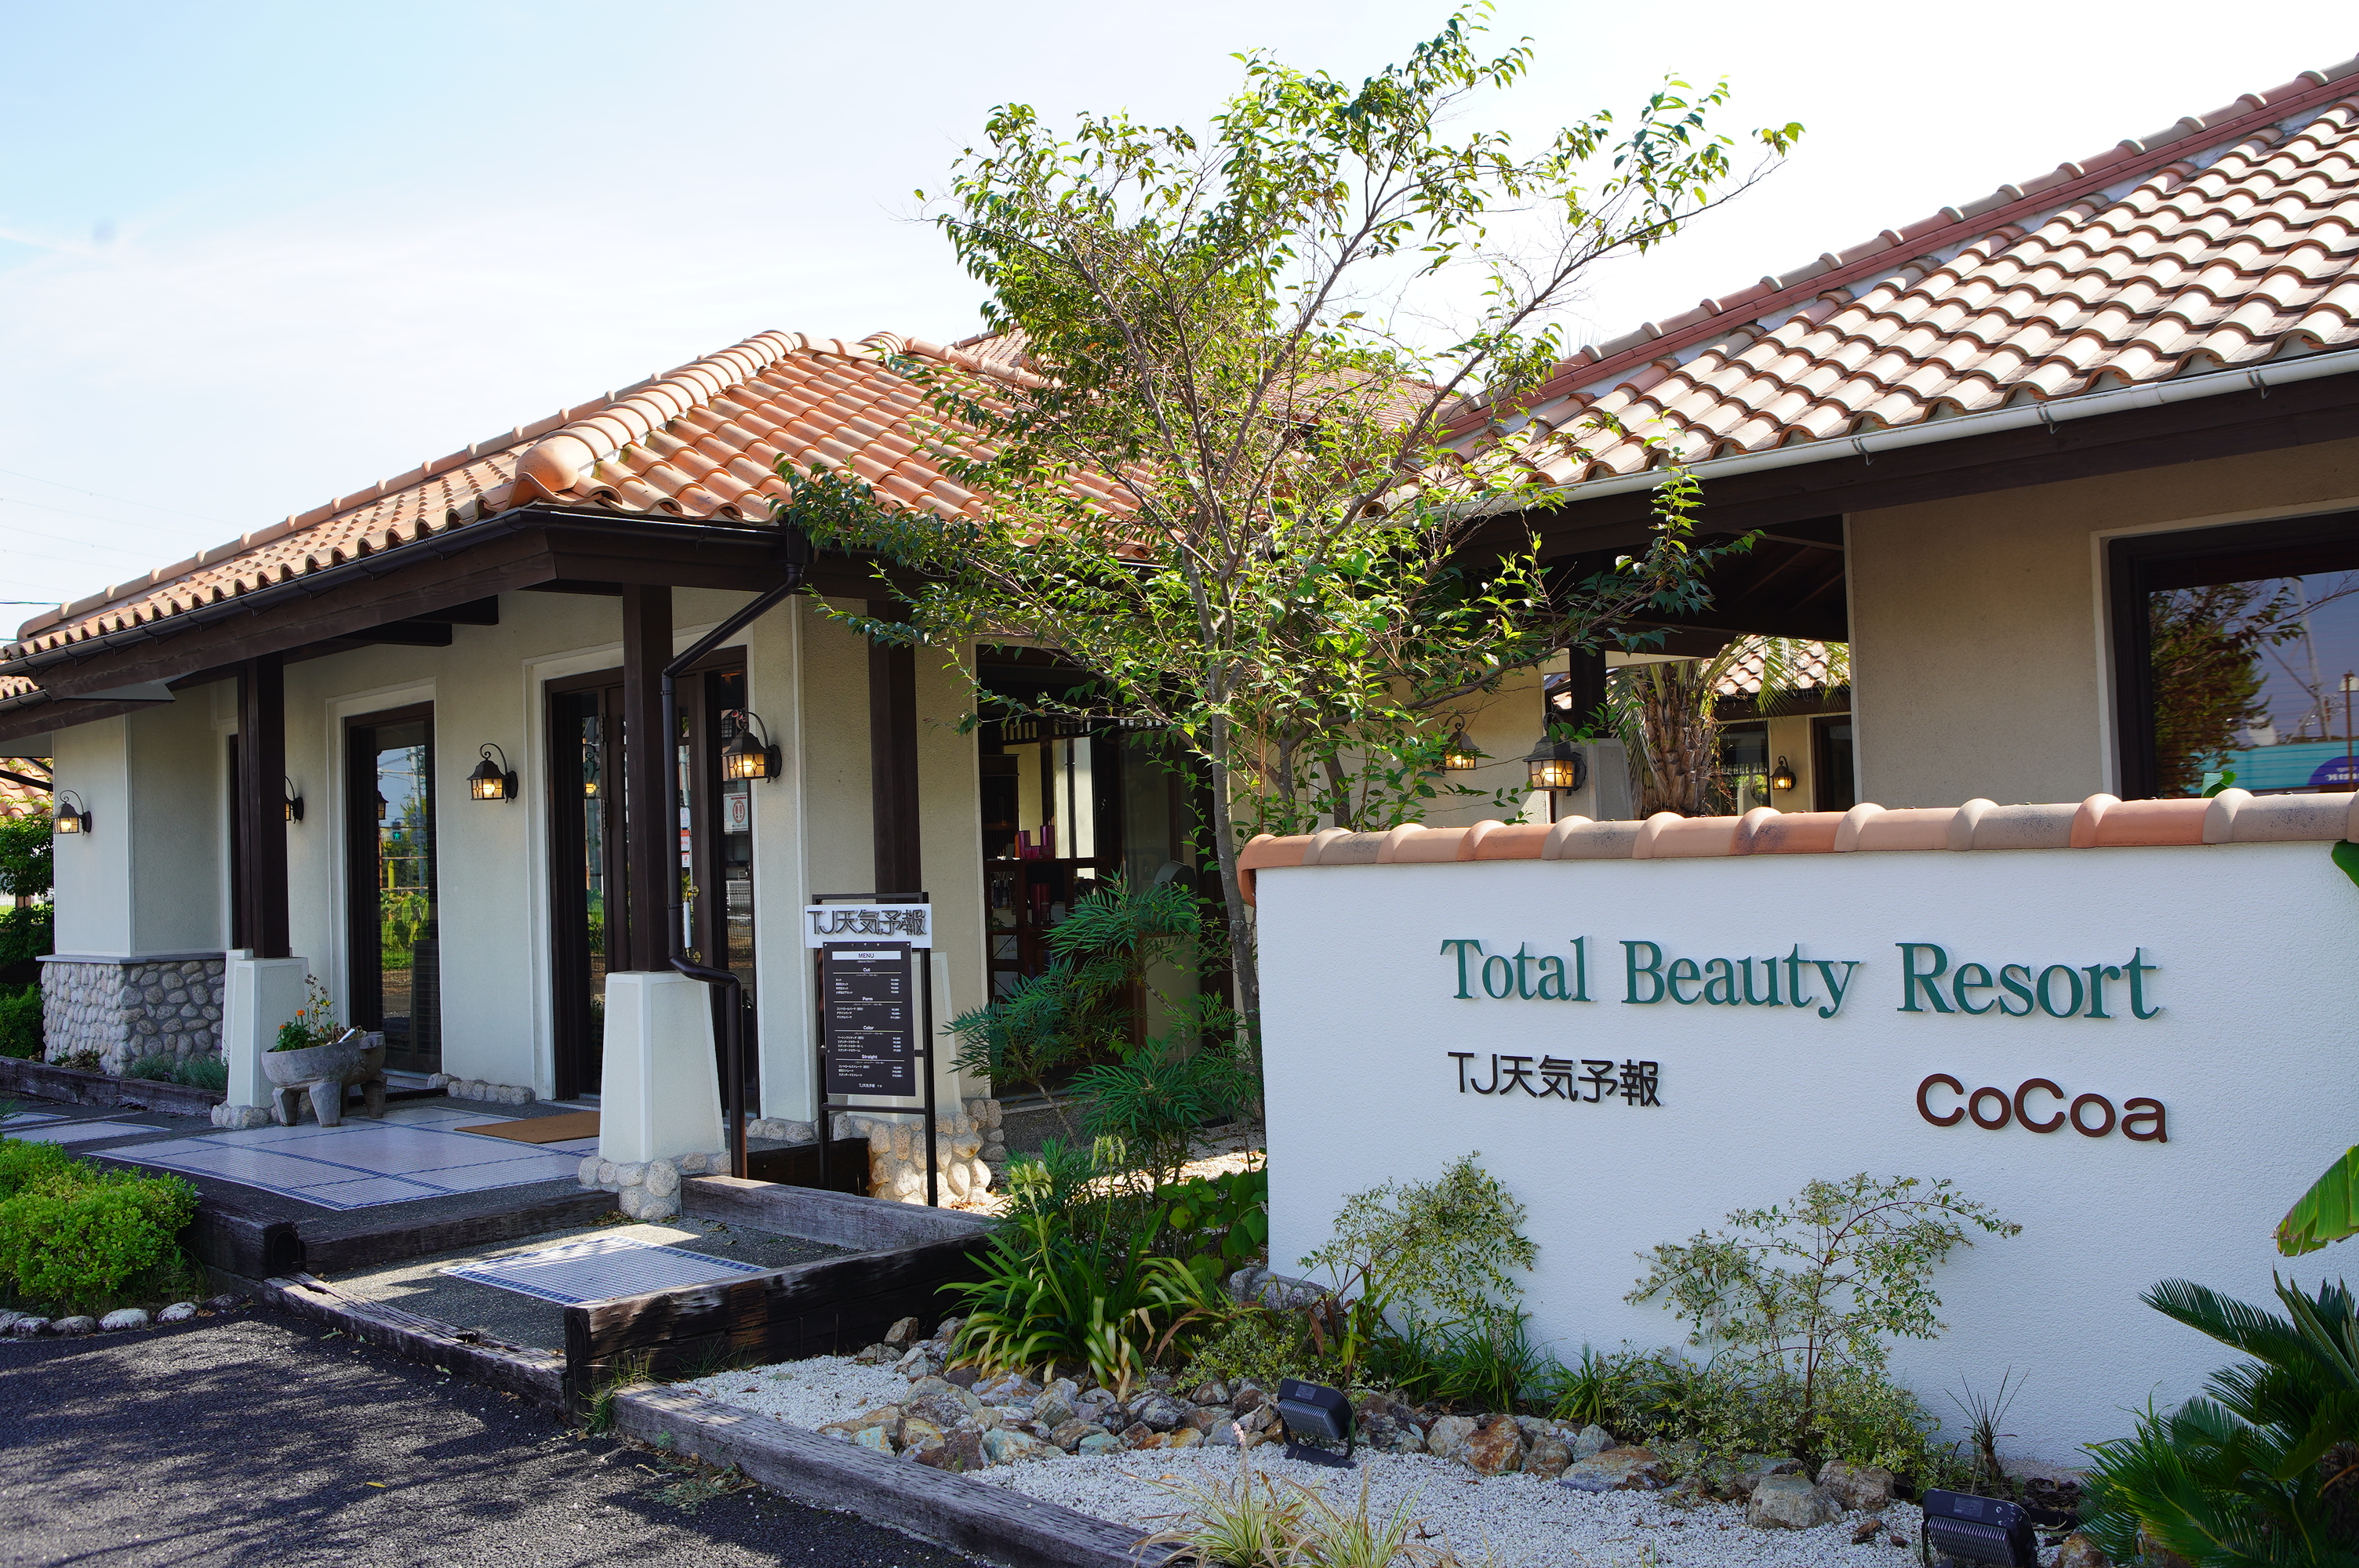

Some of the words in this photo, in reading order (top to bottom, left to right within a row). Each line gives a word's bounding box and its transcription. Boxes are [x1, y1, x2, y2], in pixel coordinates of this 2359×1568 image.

[807, 909, 927, 936] TJ天気予報
[1441, 935, 1592, 1003] Total
[1619, 940, 1861, 1020] Beauty
[1896, 942, 2161, 1021] Resort
[1447, 1051, 1662, 1108] TJ天気予報
[1916, 1073, 2168, 1144] CoCoa
